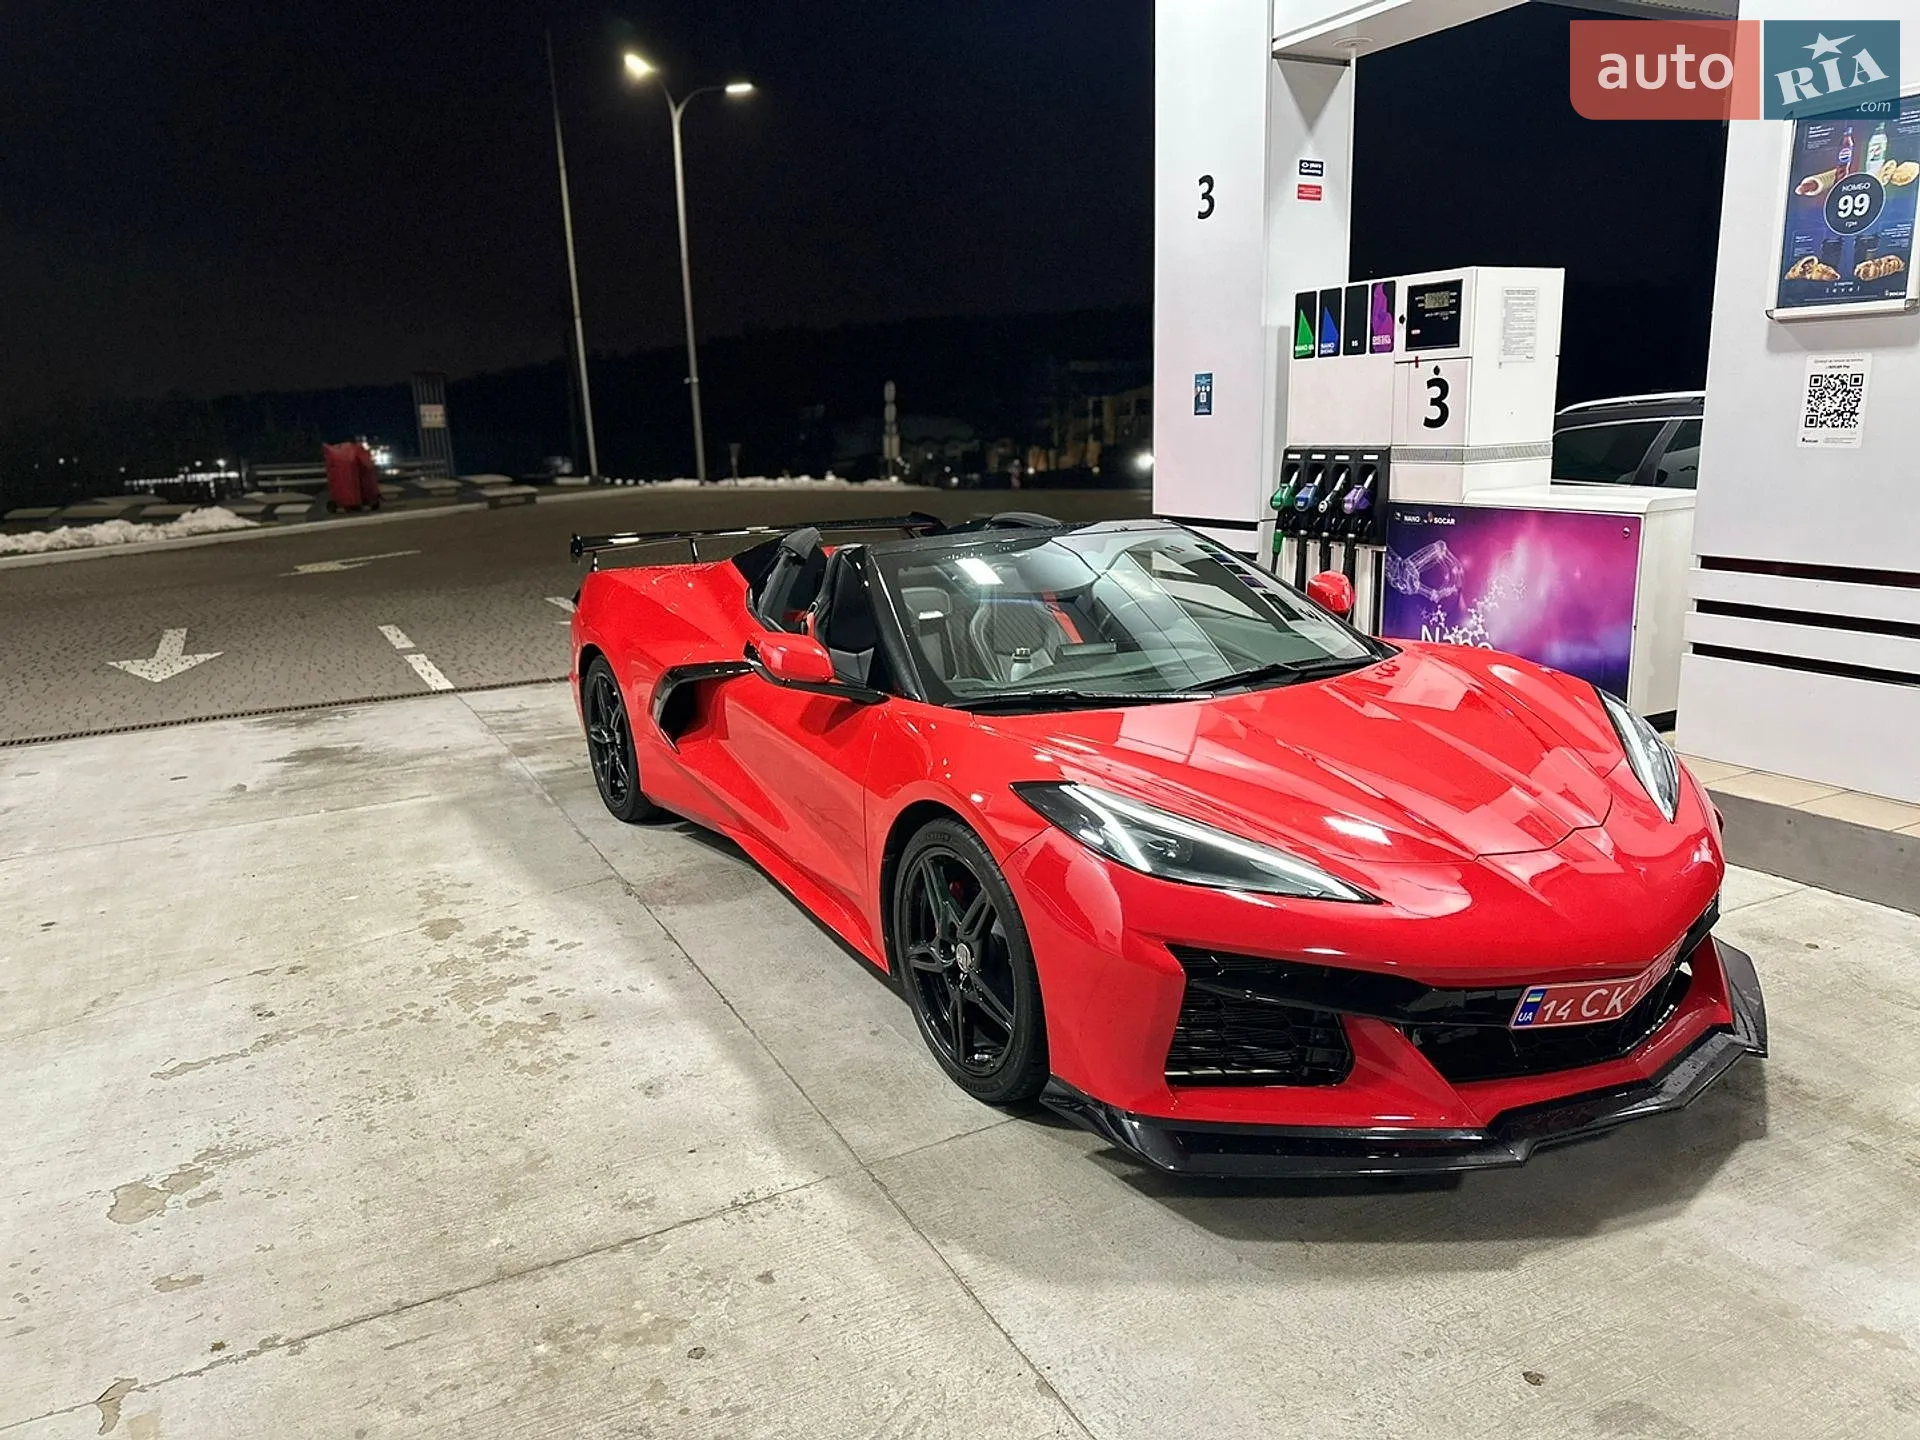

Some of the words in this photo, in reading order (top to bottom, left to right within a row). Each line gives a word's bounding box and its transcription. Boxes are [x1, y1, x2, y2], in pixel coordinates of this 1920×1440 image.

[1197, 174, 1215, 220] 3
[1837, 193, 1871, 218] 99
[1423, 377, 1450, 429] 3
[1433, 516, 1456, 525] SOCAR
[1517, 1012, 1533, 1023] UA
[1543, 998, 1575, 1023] 14
[1580, 984, 1635, 1019] CK
